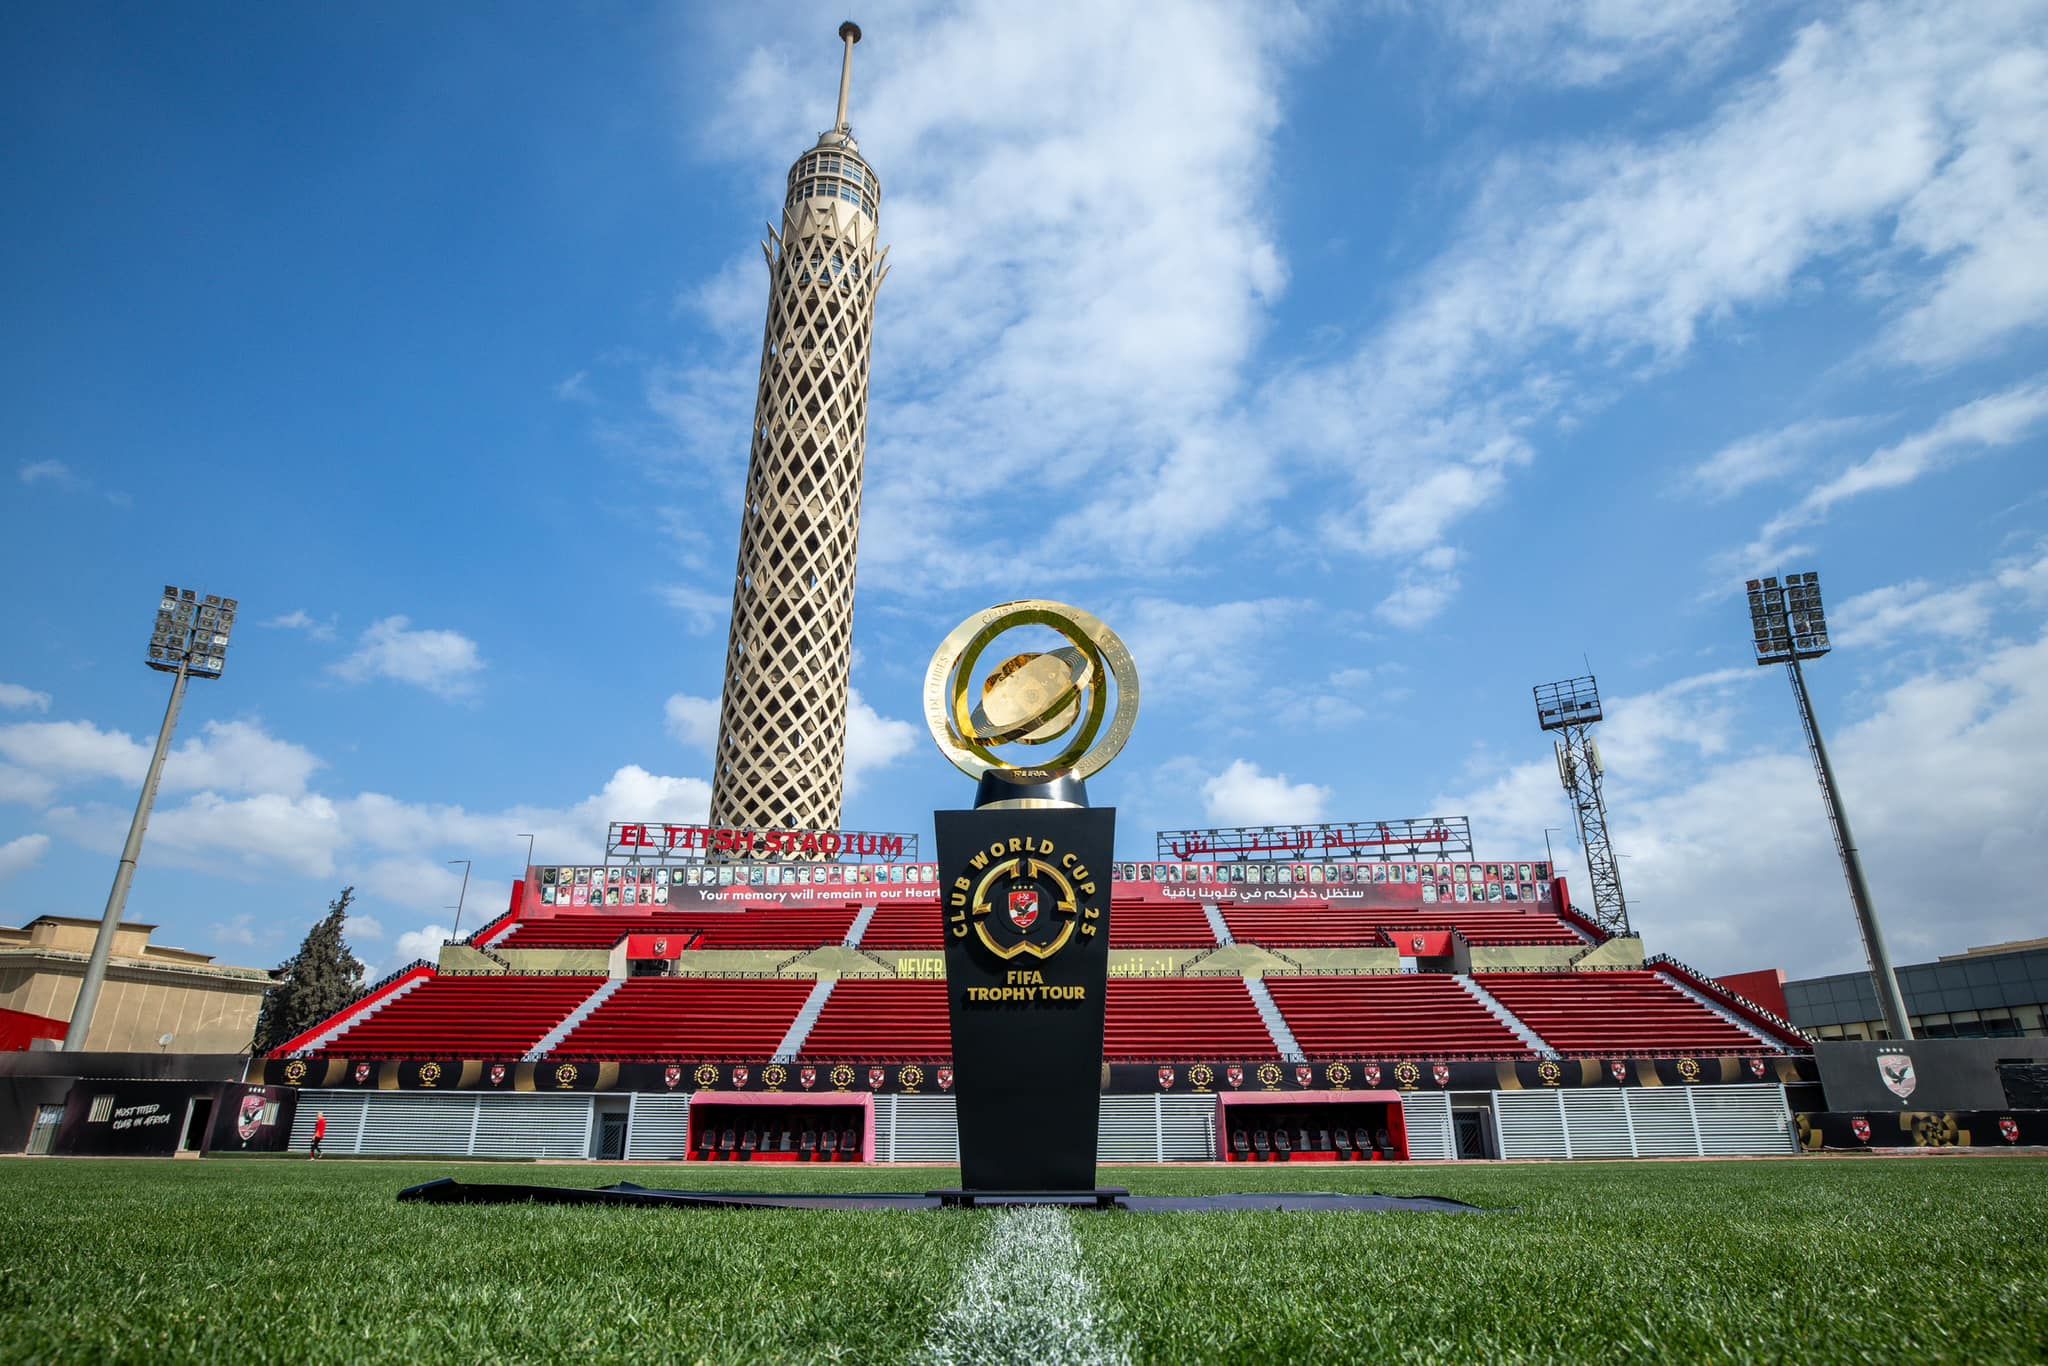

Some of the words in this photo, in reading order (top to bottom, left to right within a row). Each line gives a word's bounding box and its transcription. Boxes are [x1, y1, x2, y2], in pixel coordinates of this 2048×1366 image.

[620, 825, 654, 847] EL
[665, 827, 755, 850] TITSH
[766, 831, 904, 856] STADIUM
[950, 876, 971, 938] CLUB
[969, 836, 1055, 871] WORLD
[1062, 852, 1096, 896] CUP
[1080, 907, 1100, 938] 25
[1162, 886, 1196, 899] باقية
[1198, 887, 1238, 900] قلوبنا
[1264, 887, 1317, 900] ذكراكم
[1320, 888, 1364, 900] ستظل
[699, 890, 729, 900] Your
[732, 890, 787, 903] memory
[791, 889, 814, 900] will
[817, 889, 862, 899] remain
[865, 889, 877, 899] in
[880, 889, 903, 899] our
[1240, 888, 1261, 903] في
[898, 958, 943, 979] NEVER
[1007, 970, 1044, 986] FIFA
[967, 986, 1037, 1001] TROPHY
[1039, 986, 1086, 1000] TOUR
[114, 1107, 136, 1118] MOST
[136, 1104, 160, 1115] TITLED
[112, 1118, 133, 1130] CLUB
[133, 1117, 144, 1127] IN
[143, 1113, 171, 1127] AFRICA
